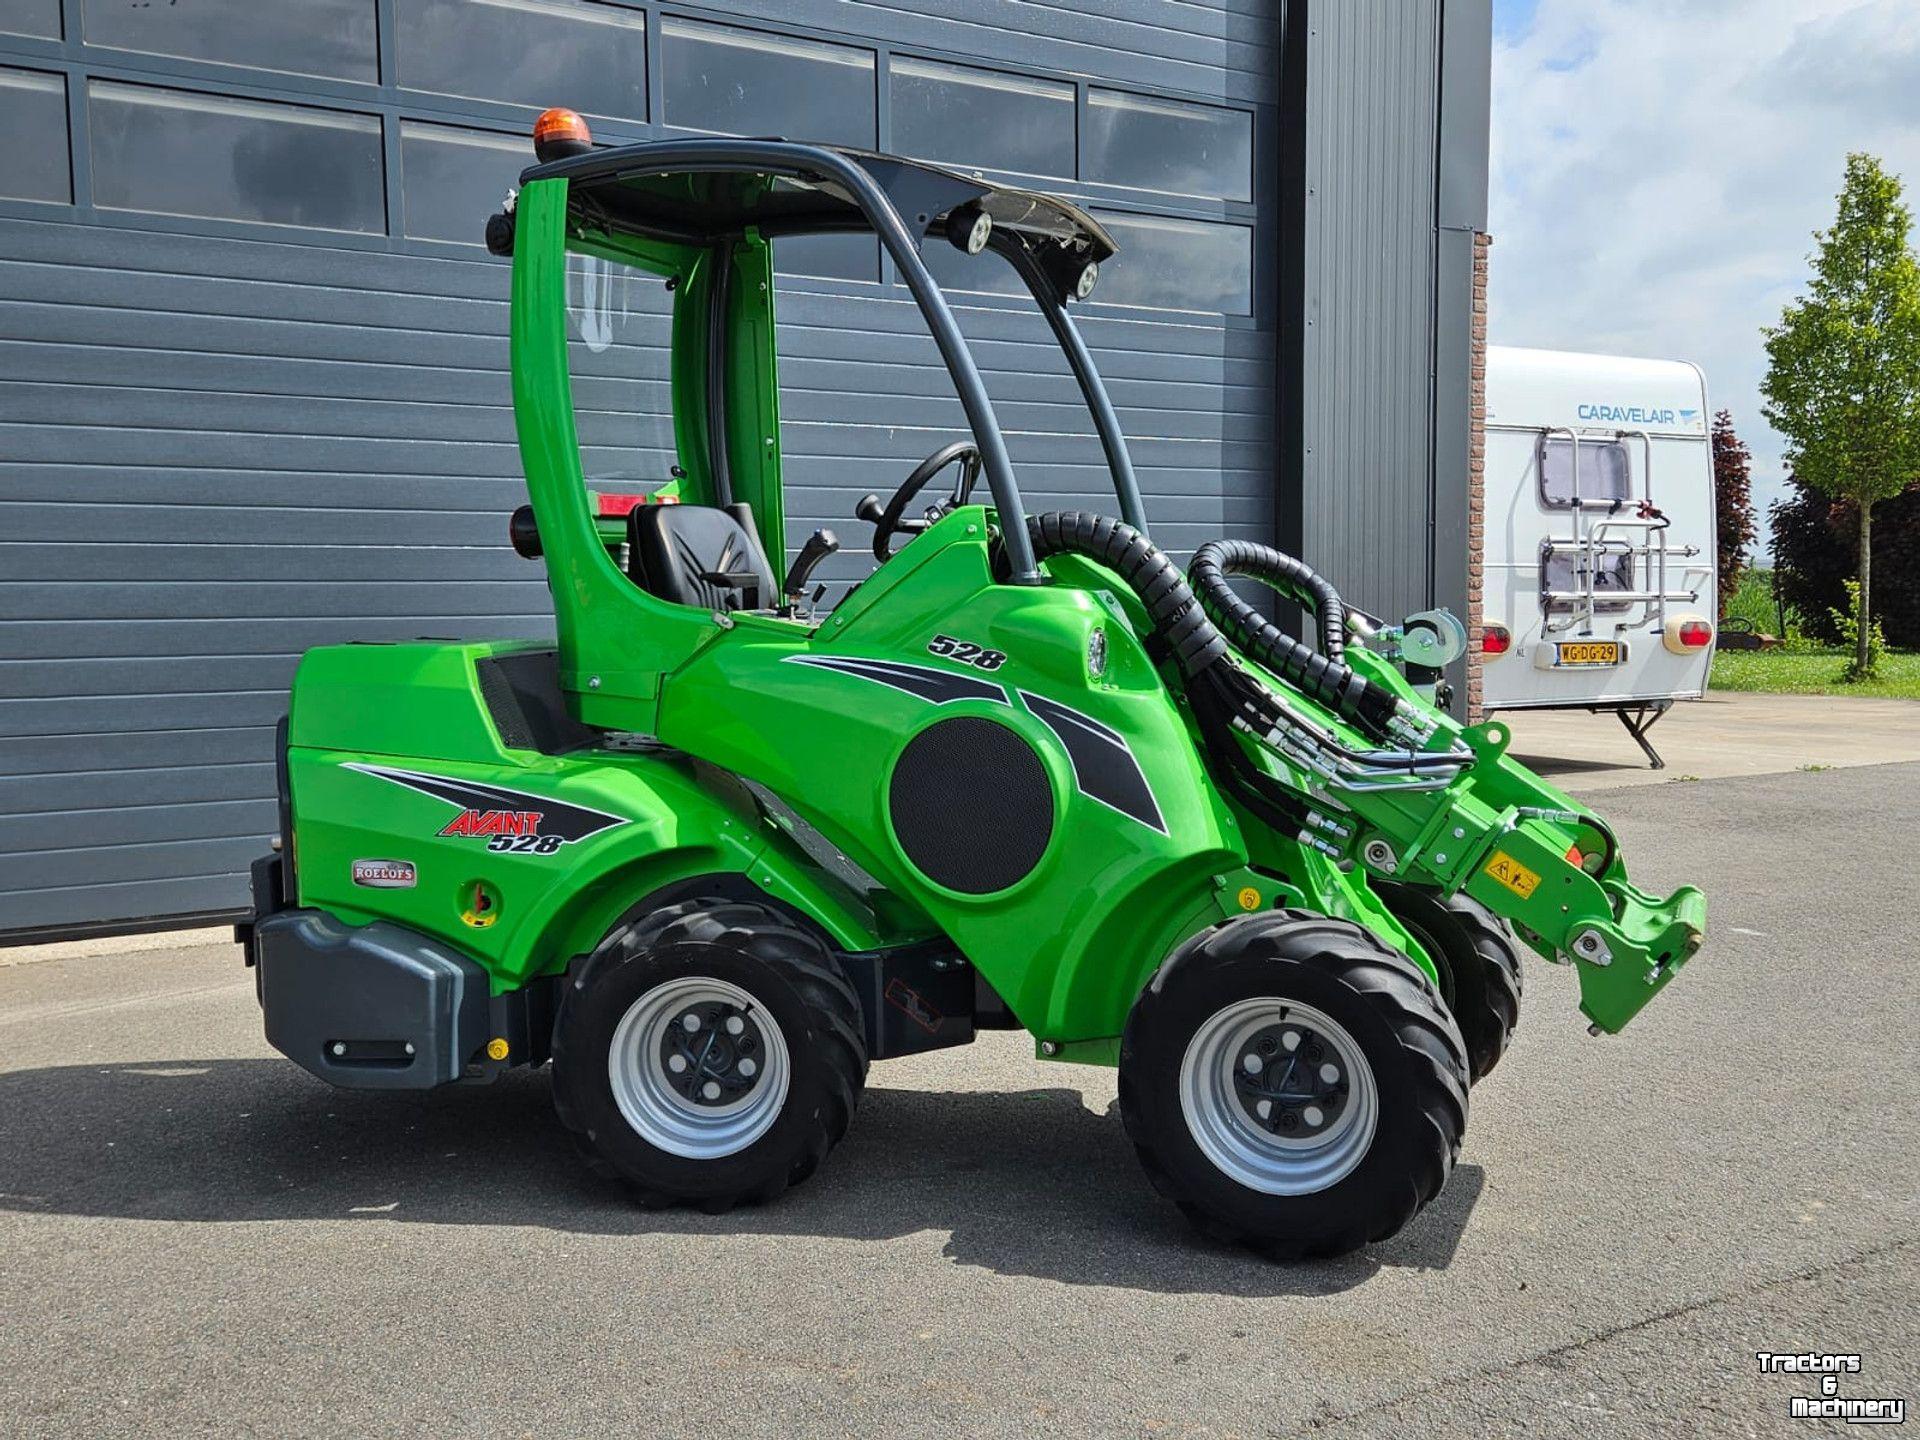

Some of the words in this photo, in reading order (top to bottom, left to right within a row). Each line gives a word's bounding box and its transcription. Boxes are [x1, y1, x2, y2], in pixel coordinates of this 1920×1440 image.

[1578, 405, 1675, 424] CARAVELAIR
[928, 635, 1007, 670] 528
[1562, 644, 1614, 660] WG-DG-29
[438, 809, 543, 836] AVANT
[487, 835, 563, 855] 528
[355, 867, 413, 880] ROELOFS
